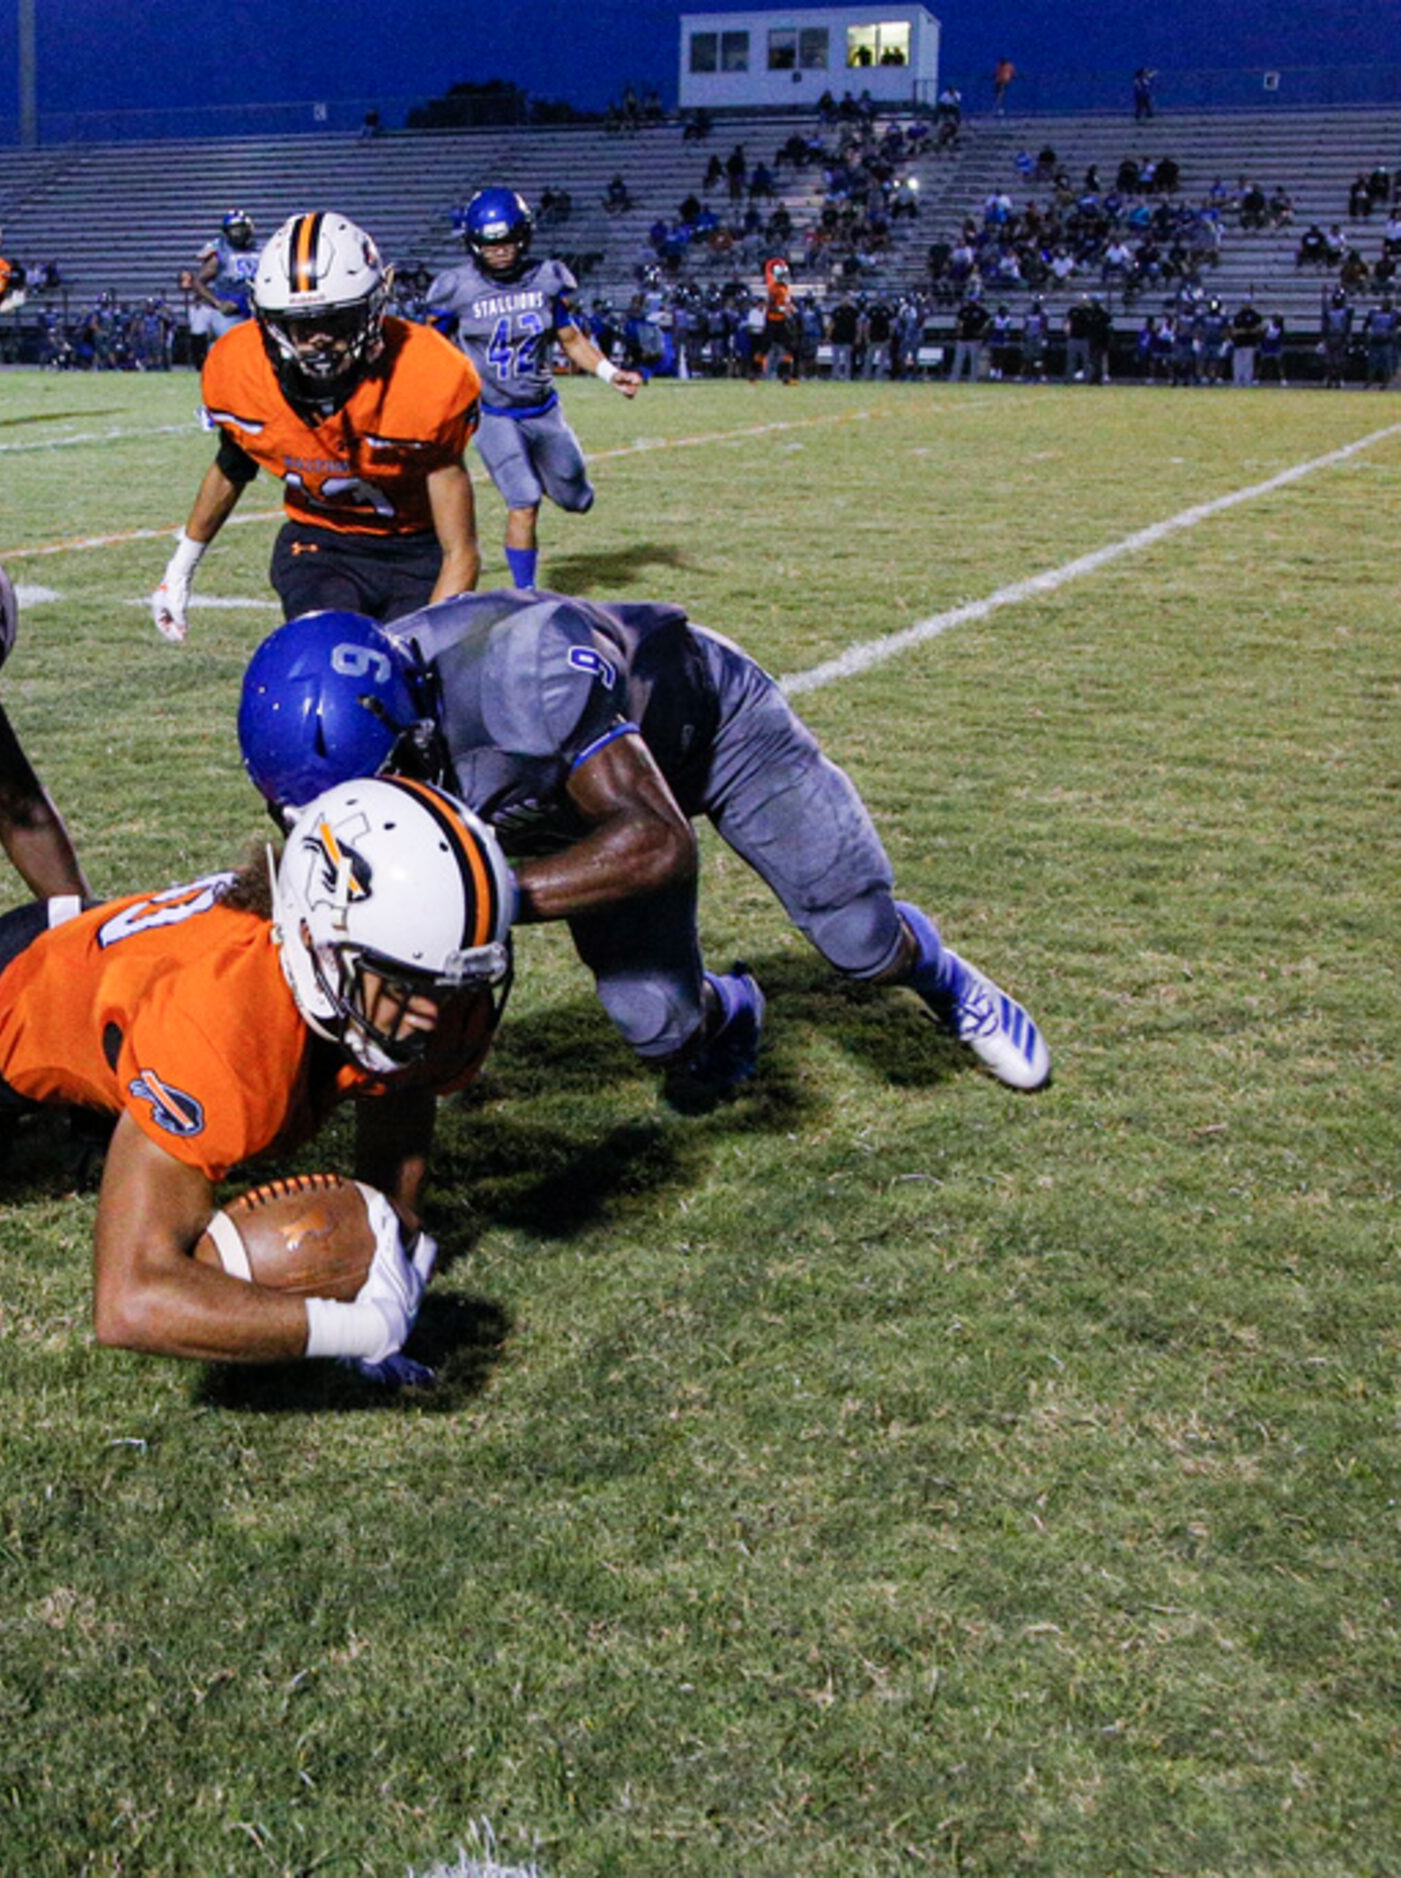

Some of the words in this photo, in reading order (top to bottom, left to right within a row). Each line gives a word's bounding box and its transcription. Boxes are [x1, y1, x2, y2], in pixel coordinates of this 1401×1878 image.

[472, 290, 544, 319] STALLIONS
[486, 311, 544, 381] 42
[567, 645, 616, 690] 9
